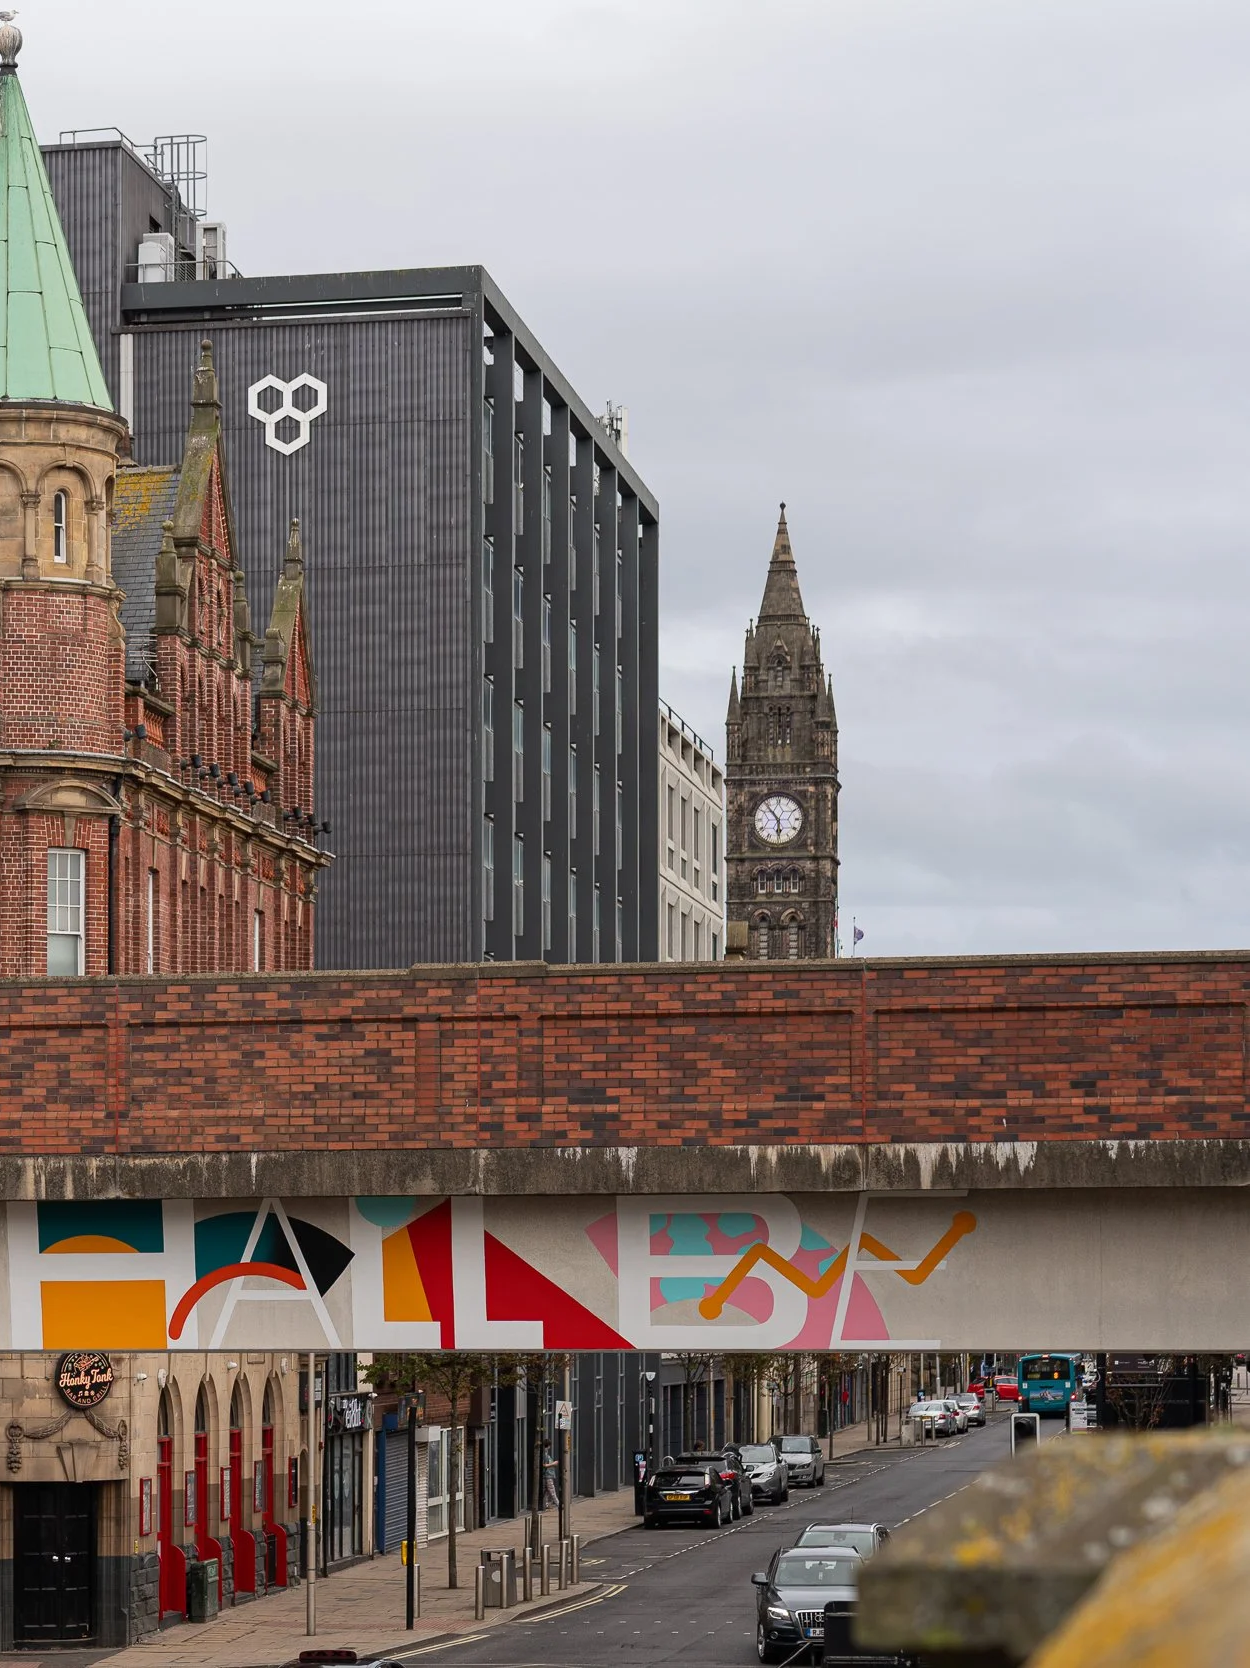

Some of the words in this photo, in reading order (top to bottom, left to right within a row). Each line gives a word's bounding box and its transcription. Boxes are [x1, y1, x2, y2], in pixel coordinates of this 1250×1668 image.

[617, 1190, 971, 1350] BE
[59, 1371, 91, 1389] Honky
[91, 1368, 114, 1383] Tonk
[65, 1388, 77, 1400] BAR
[92, 1385, 108, 1402] GRILL
